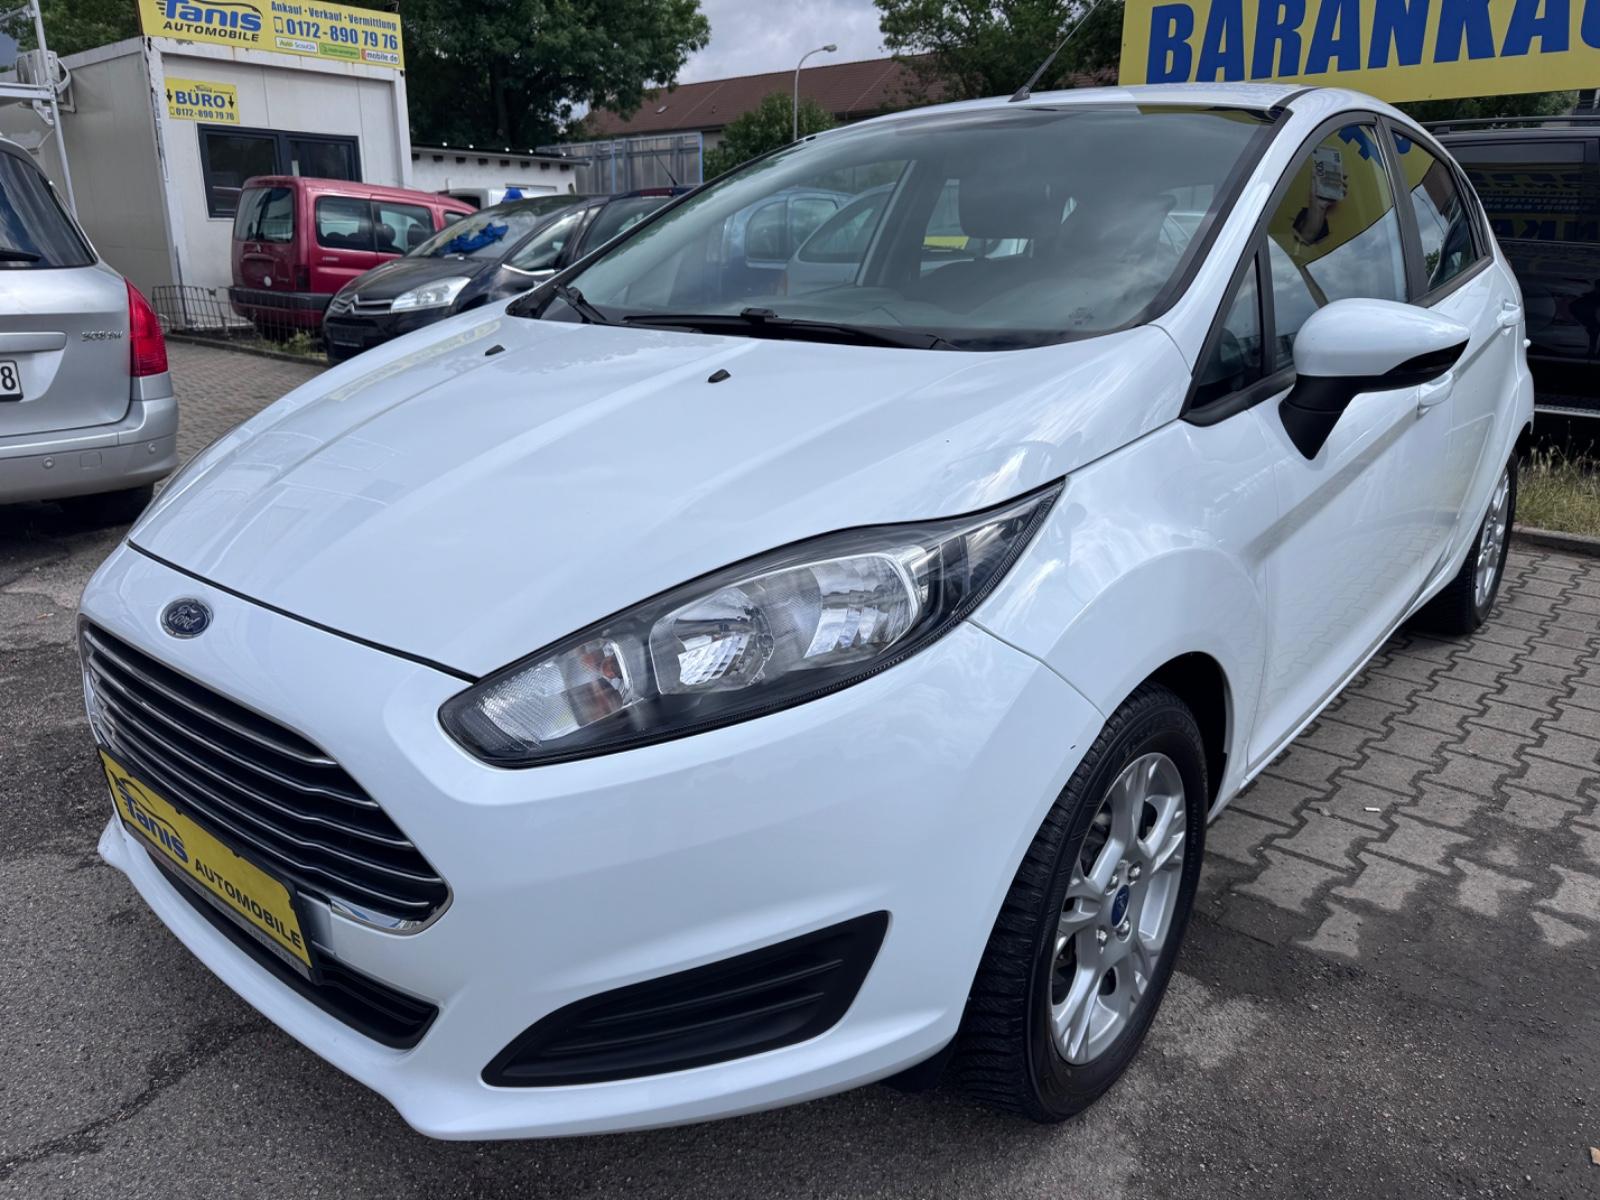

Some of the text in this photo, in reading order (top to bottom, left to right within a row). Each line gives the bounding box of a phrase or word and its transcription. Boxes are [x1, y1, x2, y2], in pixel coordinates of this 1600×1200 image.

[163, 21, 260, 42] AUTOMOBILE
[165, 0, 262, 32] Tanis
[271, 1, 397, 32] Ankauf Verkauf Vermittlung
[361, 30, 378, 48] 79
[382, 33, 399, 50] 76
[1146, 0, 1600, 84] BARANKA
[174, 89, 226, 109] BÜRO
[126, 795, 189, 864] Tanis
[195, 858, 302, 950] AUTOMOBILE
